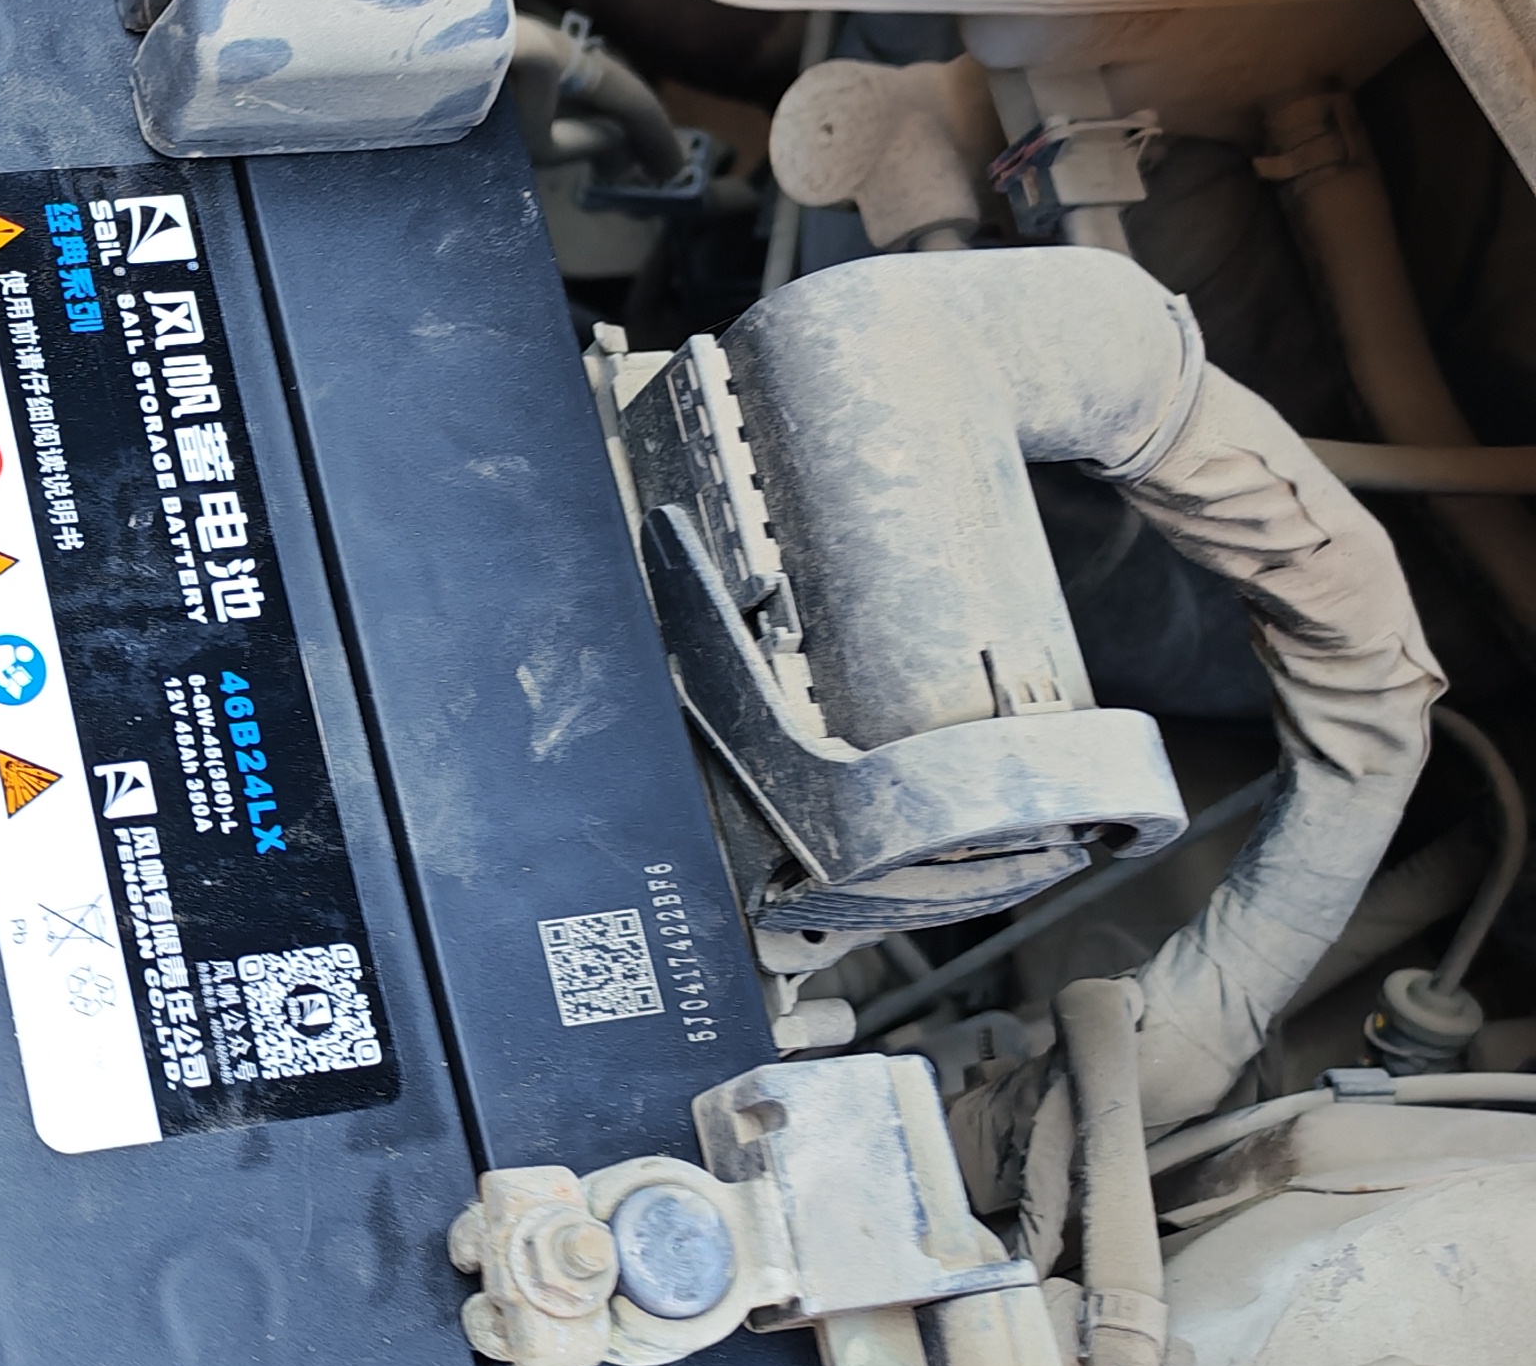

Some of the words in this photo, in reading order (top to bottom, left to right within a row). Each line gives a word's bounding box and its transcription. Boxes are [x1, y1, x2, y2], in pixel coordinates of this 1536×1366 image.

[44, 203, 105, 333] 经典系列
[117, 294, 146, 355] SAIL
[132, 362, 178, 490] STORAGE
[162, 497, 209, 629] BATTERY
[143, 290, 266, 623] 风帆蓄电池
[164, 677, 189, 715] 12V
[174, 721, 201, 774] 45Ah
[188, 675, 239, 835] 6-QW-45(350)-L
[220, 671, 287, 855] 46B24LX
[186, 778, 214, 833] 350A
[115, 827, 157, 959] FENGFAN
[130, 827, 211, 1087] 风帆有限责任公司
[644, 863, 717, 1042] 5J0417422BF6
[208, 960, 259, 1082] 风帆公众号
